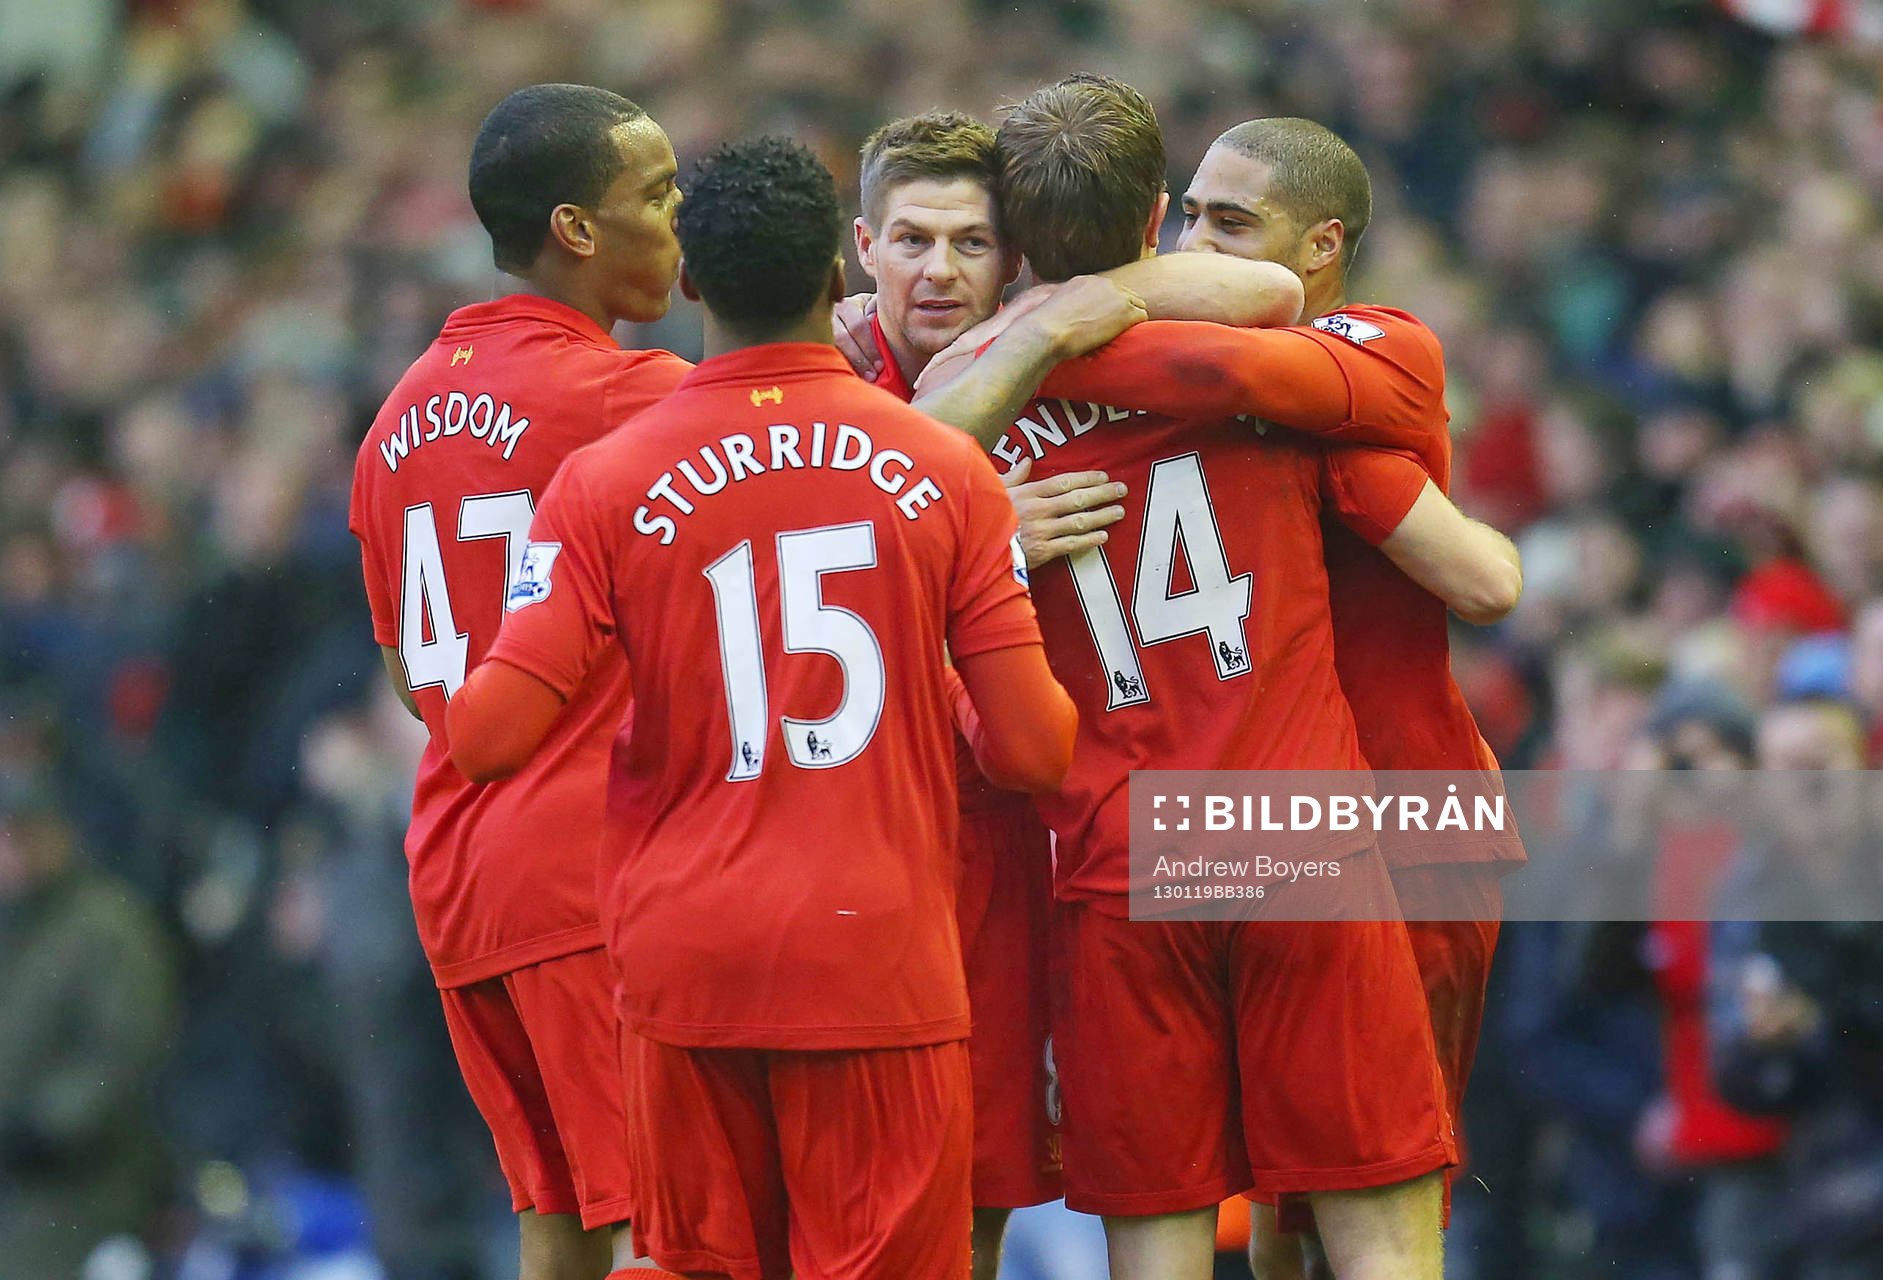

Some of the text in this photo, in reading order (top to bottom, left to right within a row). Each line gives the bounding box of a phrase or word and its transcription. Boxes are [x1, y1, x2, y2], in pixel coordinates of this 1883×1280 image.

[379, 391, 530, 473] WISDOM
[632, 421, 943, 546] STURRIDGE
[399, 488, 537, 704] 47
[702, 520, 886, 782] 15
[1066, 451, 1253, 711] 14
